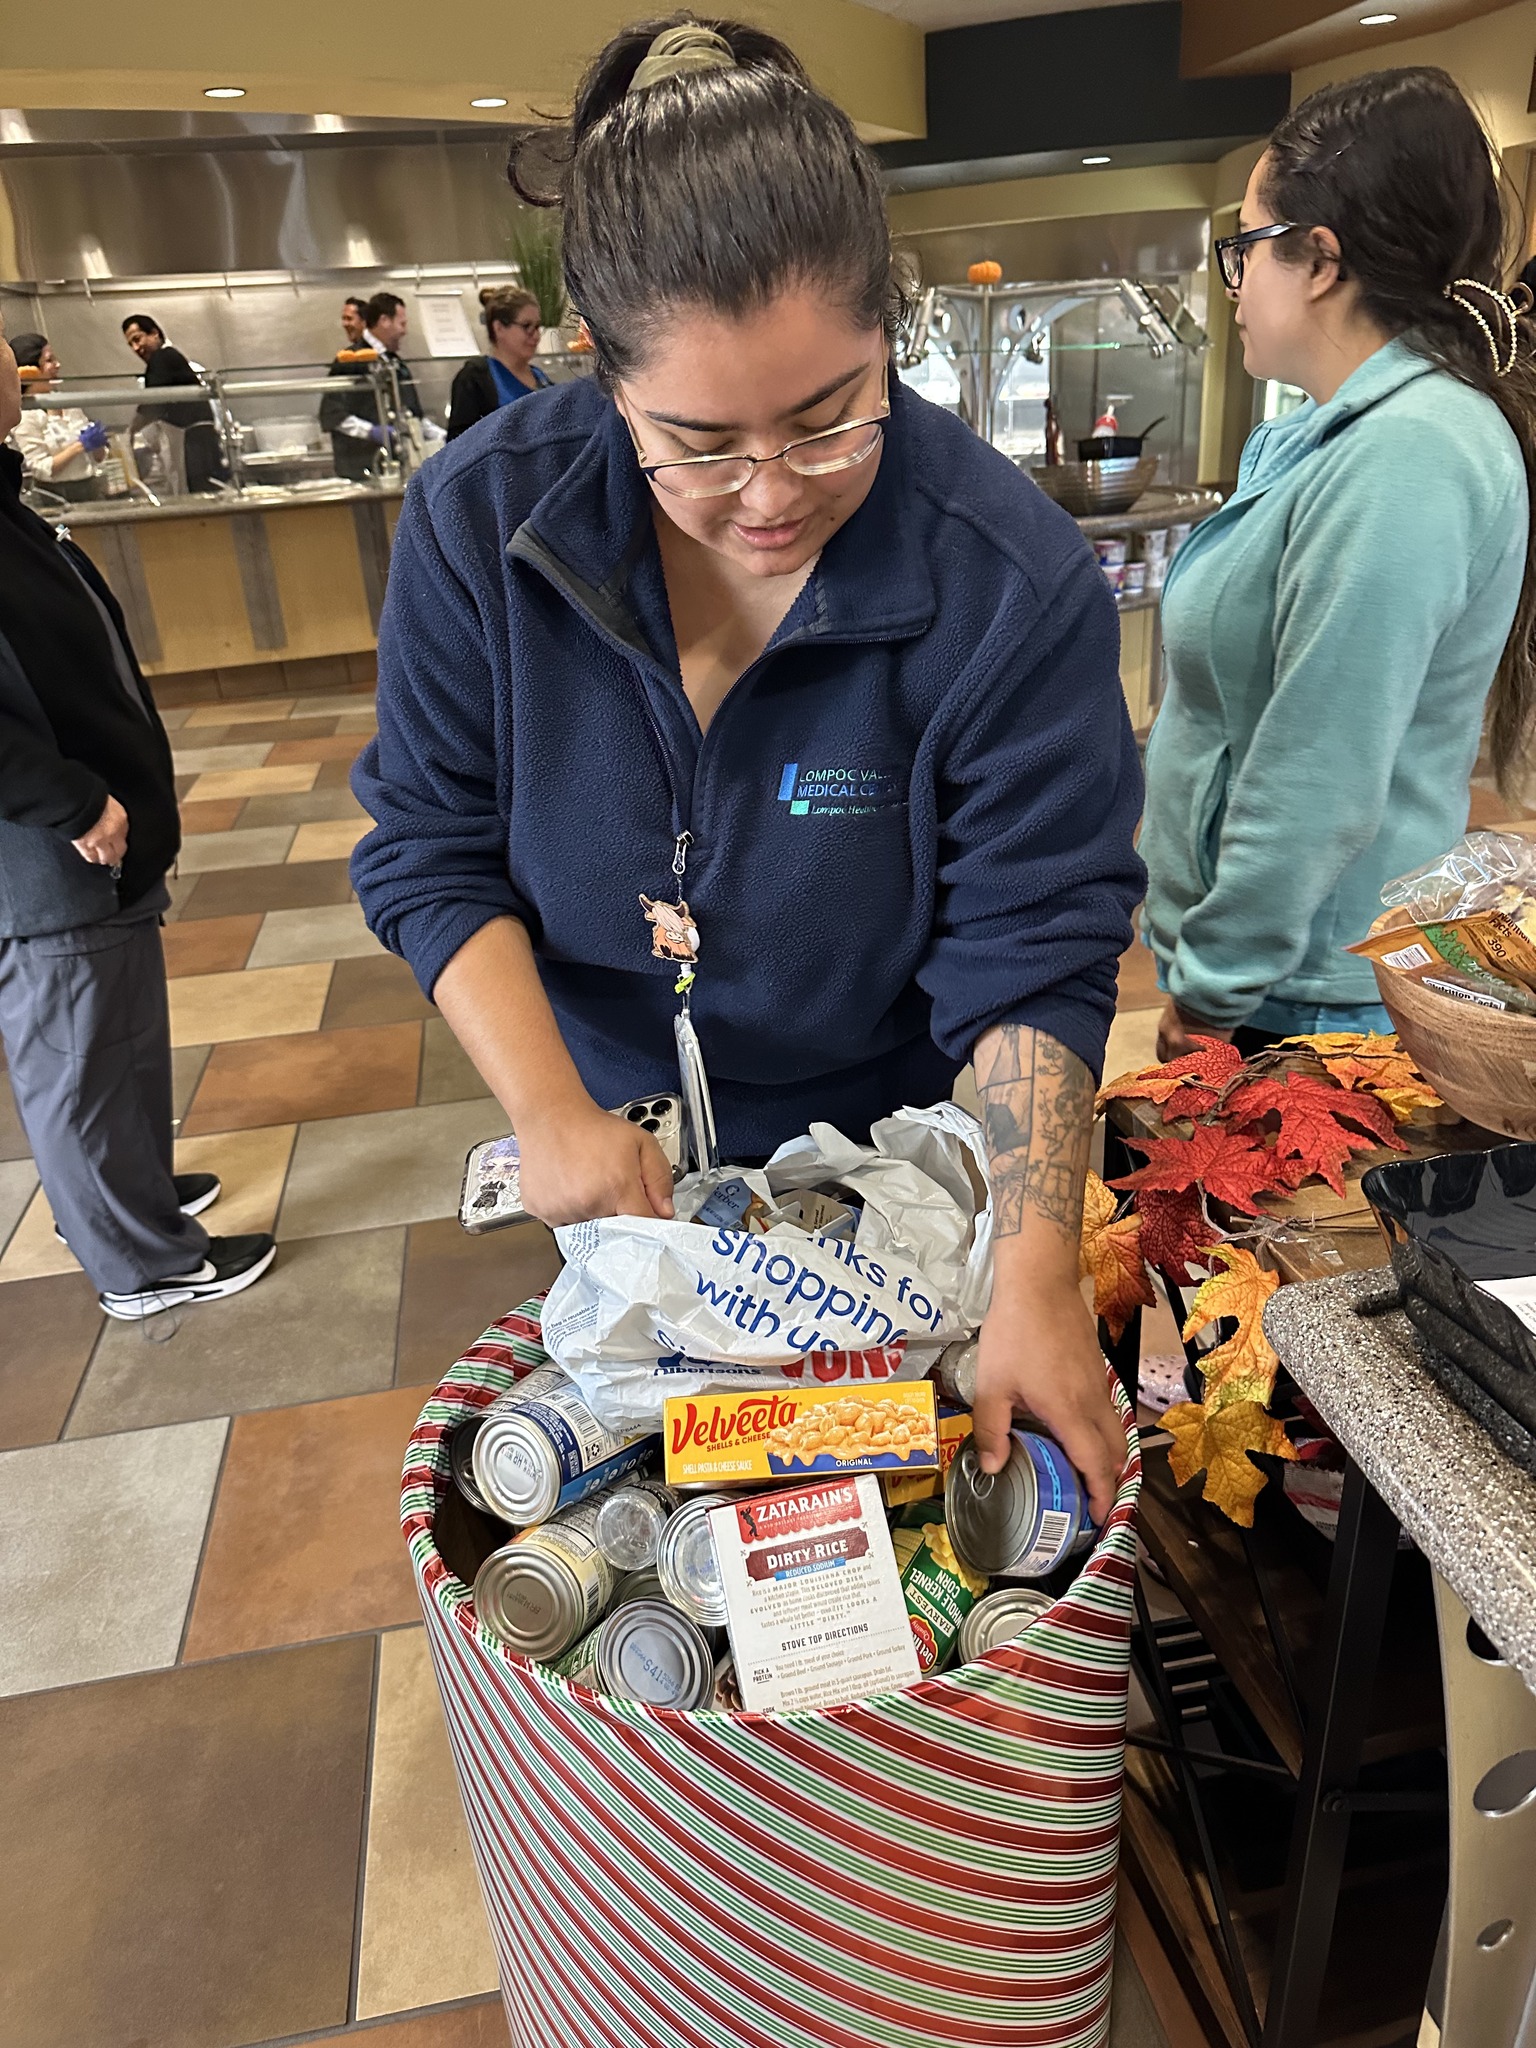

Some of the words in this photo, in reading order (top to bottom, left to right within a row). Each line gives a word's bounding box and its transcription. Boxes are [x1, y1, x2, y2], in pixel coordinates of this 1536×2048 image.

[797, 784, 856, 797] MEDICAL
[1488, 918, 1513, 938] Facts
[1487, 938, 1507, 958] 390
[713, 1187, 740, 1209] erber
[806, 1236, 887, 1288] nks
[897, 1276, 943, 1333] for
[567, 1306, 590, 1321] reusable
[696, 1270, 781, 1338] with
[672, 1395, 798, 1454] Velveeta
[706, 1440, 733, 1452] SHELLS
[742, 1432, 771, 1446] CHEESE
[683, 1463, 697, 1475] SHELL
[697, 1462, 713, 1474] PASTA
[718, 1461, 735, 1472] CHEESE
[735, 1460, 752, 1471] SAUCE
[835, 1457, 873, 1468] ORIGINAL
[756, 1487, 853, 1522] ZATARAIN'S
[766, 1547, 811, 1570] DIRTY
[814, 1540, 849, 1559] RICE
[773, 1581, 797, 1592] MAJOR
[800, 1571, 840, 1585] LOUISIANA
[842, 1566, 861, 1576] CROP
[785, 1564, 811, 1578] REDUCED
[812, 1560, 836, 1572] SODIUM
[811, 1579, 843, 1591] BELOVED
[846, 1574, 863, 1583] DISH
[909, 1568, 944, 1601] KERNEL
[935, 1570, 960, 1599] CORN
[750, 1602, 782, 1614] EVOLVED
[847, 1598, 869, 1608] LOOKS
[909, 1589, 951, 1633] HARVEST
[790, 1620, 814, 1630] LITTLE
[912, 1620, 929, 1640] Quality
[781, 1637, 806, 1651] STOVE
[808, 1633, 823, 1645] TOP
[825, 1623, 869, 1641] DIRECTIONS
[920, 1642, 934, 1665] Del
[753, 1673, 773, 1683] PROTEIN
[762, 1706, 775, 1714] COOK
